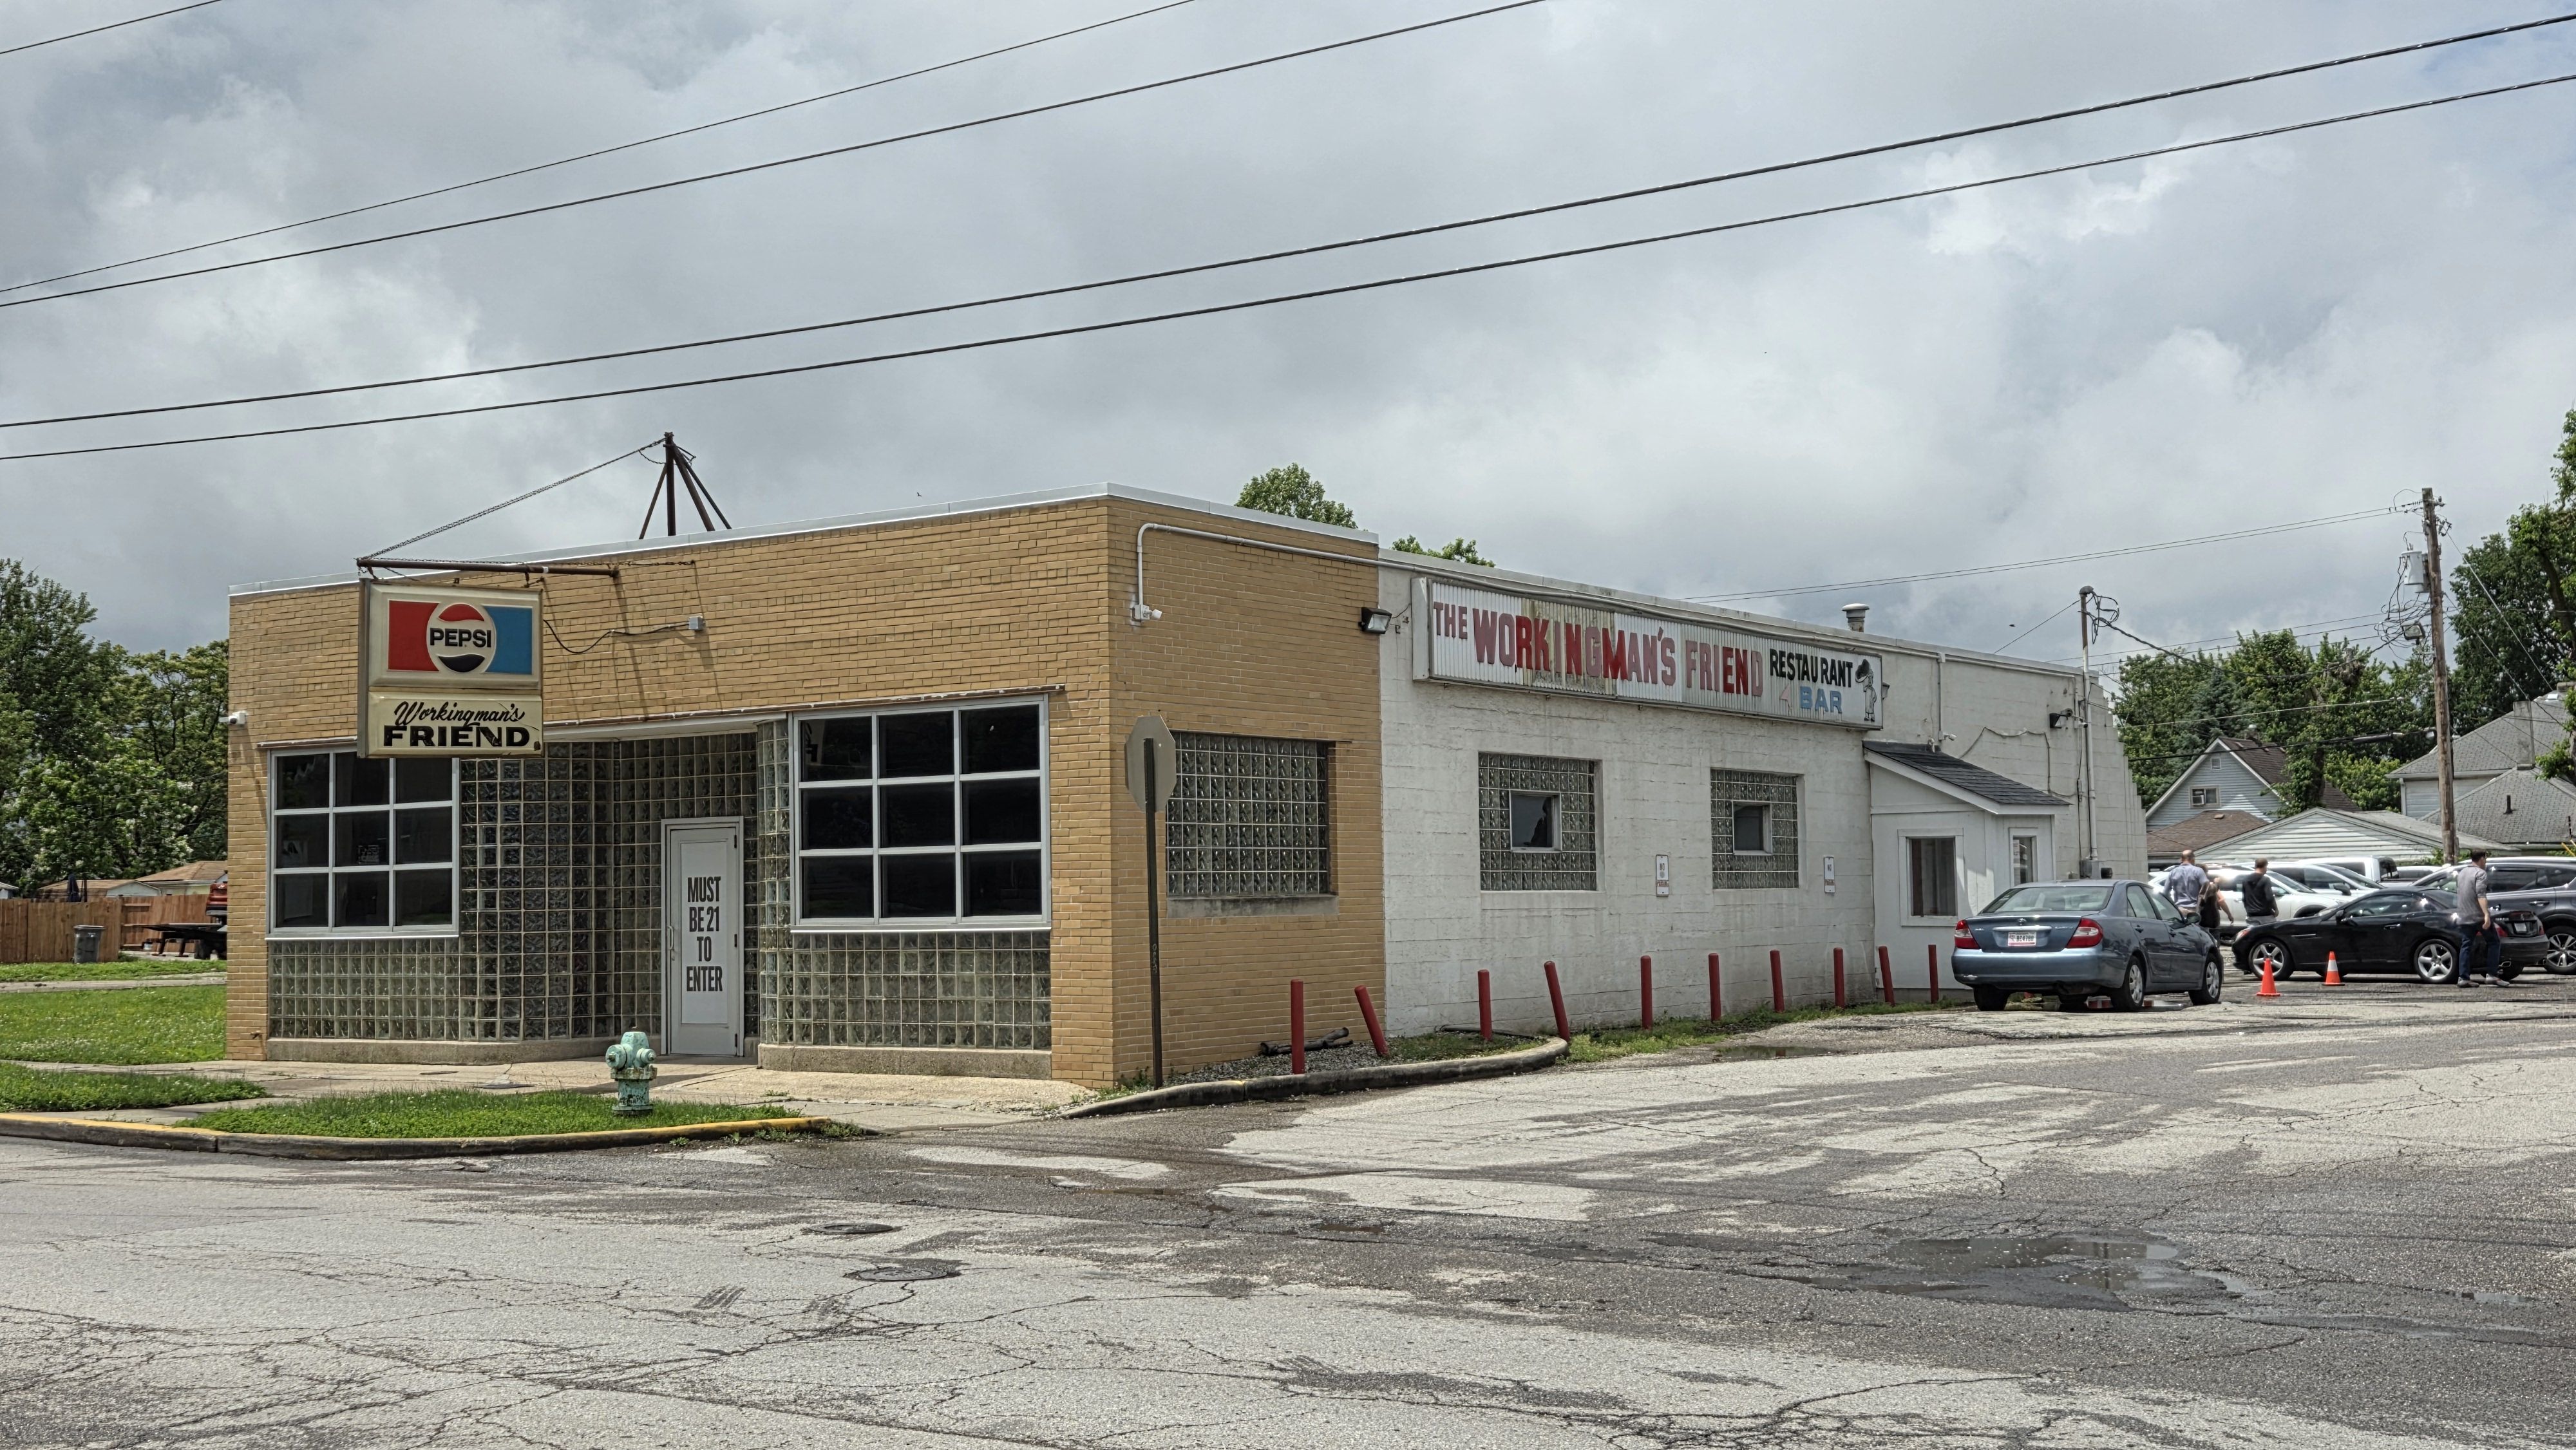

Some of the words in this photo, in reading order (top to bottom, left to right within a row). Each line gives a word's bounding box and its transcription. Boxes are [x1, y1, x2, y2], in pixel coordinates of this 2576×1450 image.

[430, 627, 491, 648] PEPSI
[1433, 601, 1468, 639] THE
[1472, 607, 1676, 686] WORKINGMAN'S
[1685, 639, 1763, 697] FRIEND
[1769, 648, 1853, 688] RESTAURANT
[1799, 685, 1843, 714] BAR
[393, 701, 526, 728] Workingman's
[383, 724, 530, 748] FRIEND
[687, 876, 721, 903] MUST
[689, 907, 704, 932] BE
[706, 906, 719, 932] 21
[696, 936, 712, 962] TO
[686, 966, 723, 992] ENTER
